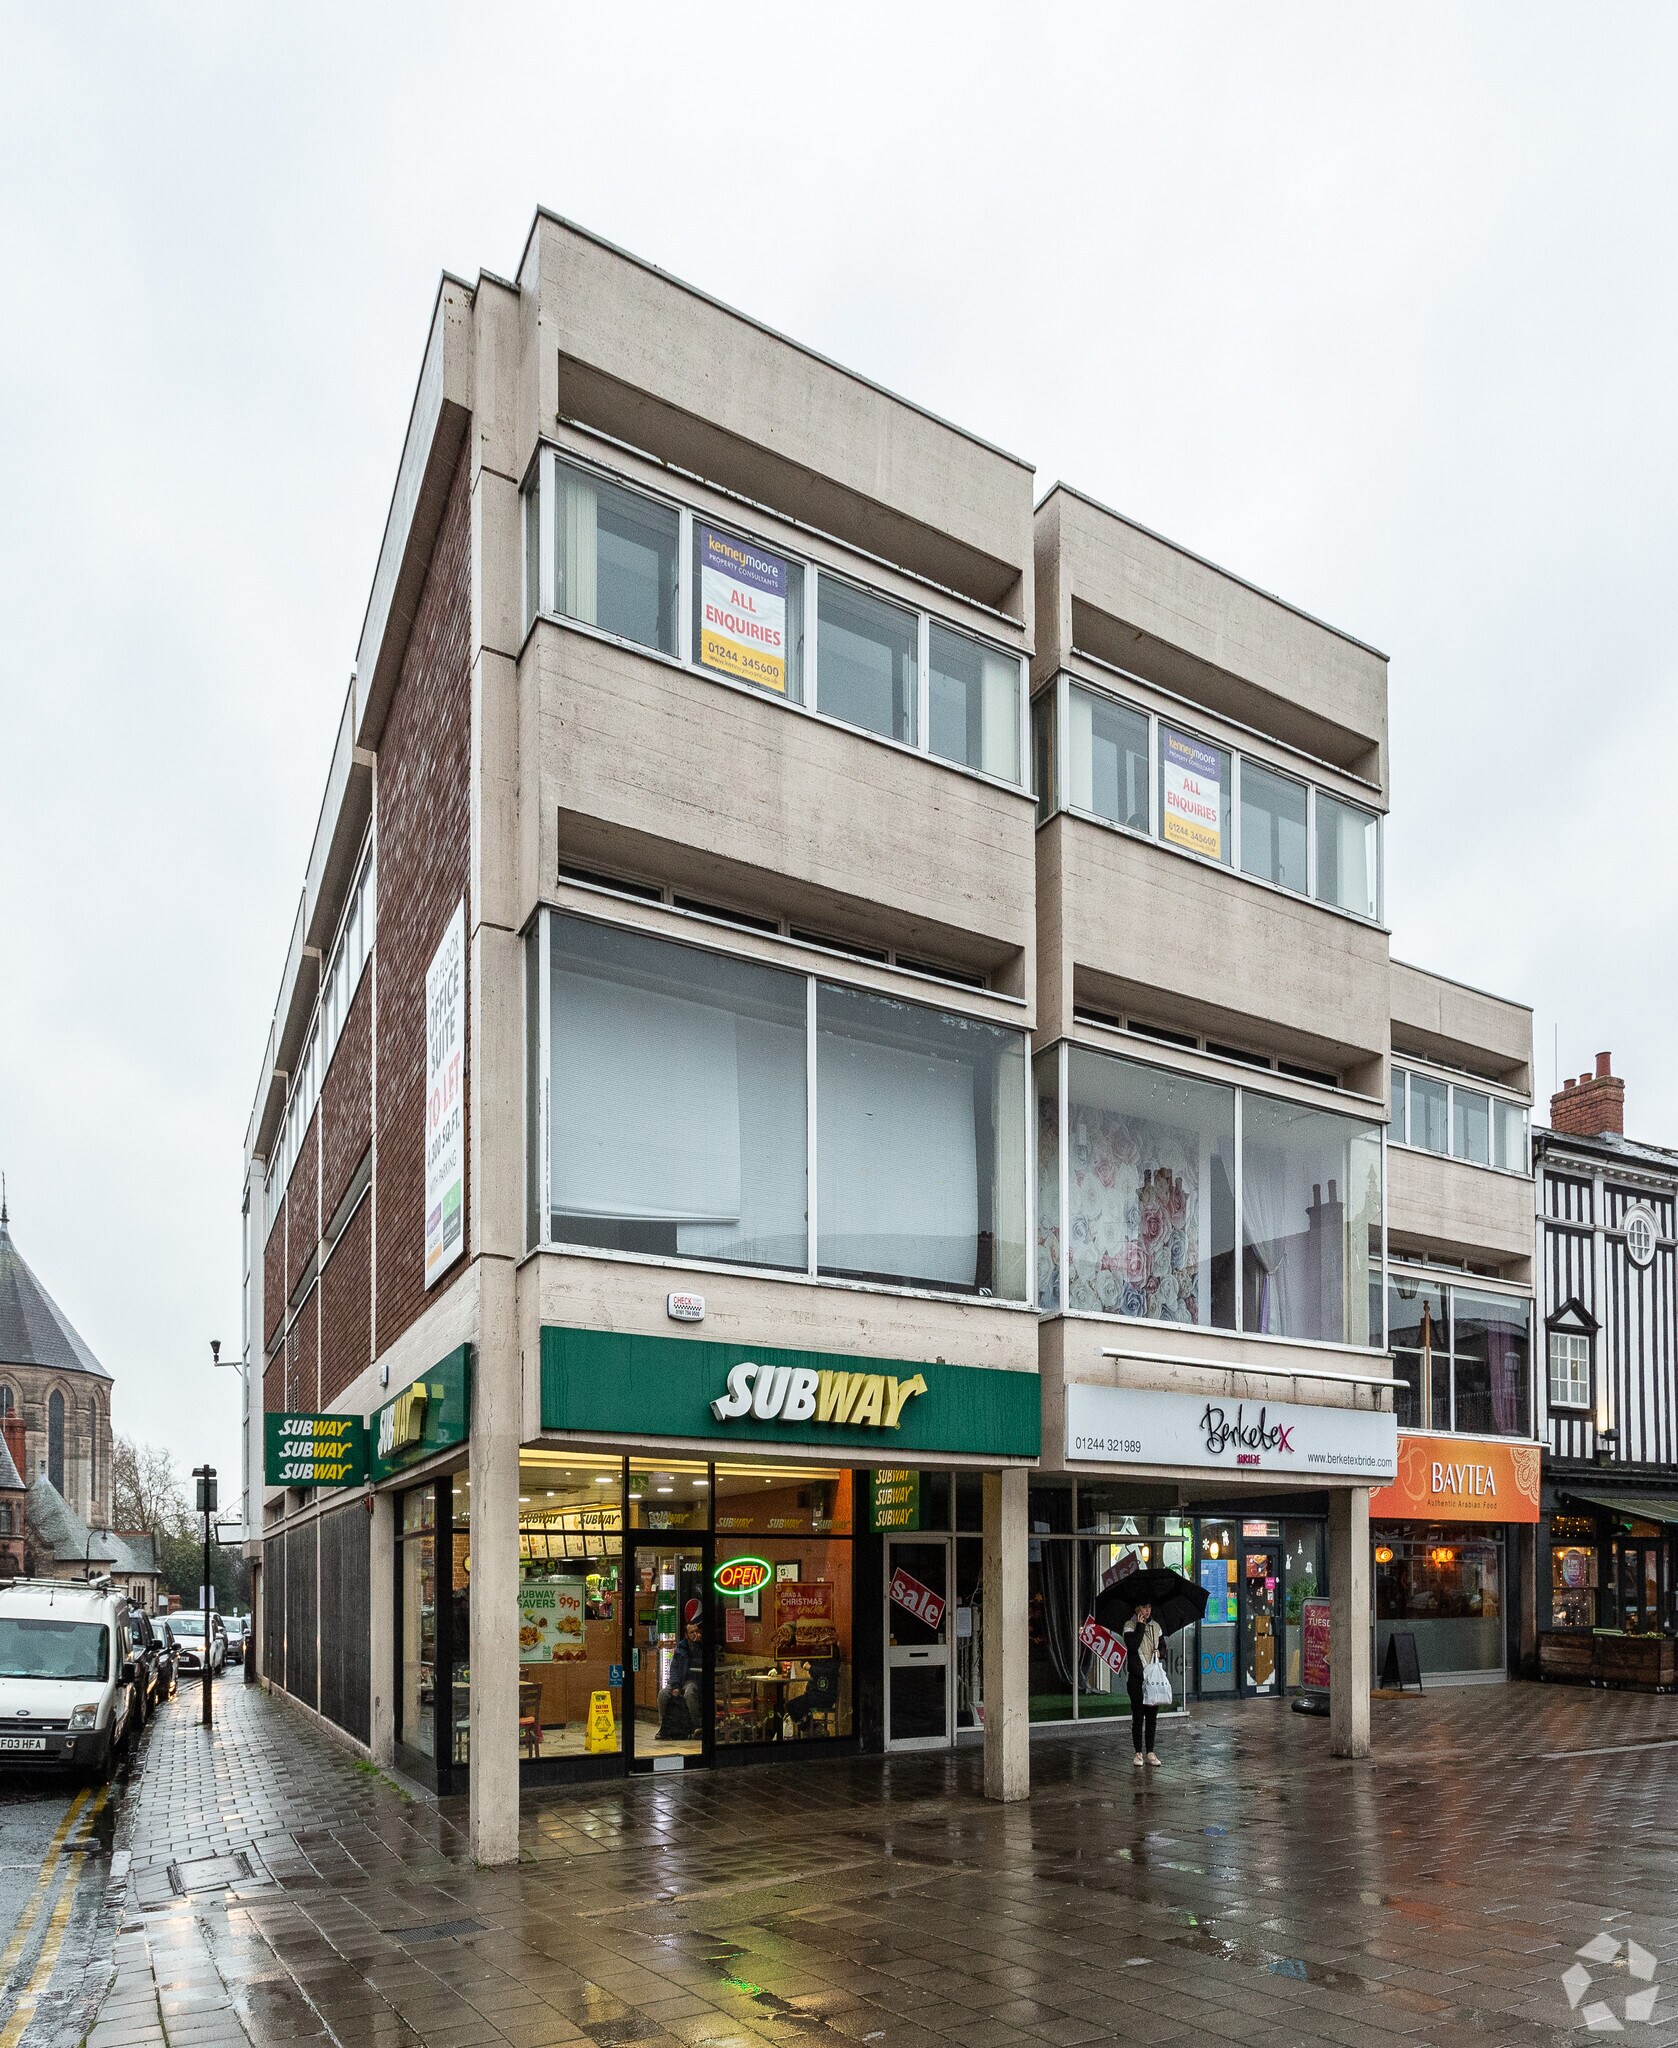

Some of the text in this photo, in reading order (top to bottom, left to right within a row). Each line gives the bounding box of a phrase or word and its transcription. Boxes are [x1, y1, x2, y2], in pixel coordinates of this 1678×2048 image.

[709, 534, 779, 577] kenneymoore
[709, 554, 778, 588] PROPERTY CONSULTANTS
[731, 590, 756, 613] ALL
[706, 604, 781, 646] ENQUIRIES
[708, 642, 779, 677] 01244 345600
[1169, 735, 1215, 766] kenneymoore
[1183, 778, 1200, 795] ALL
[1167, 791, 1216, 822] ENQUIRIES
[1168, 821, 1188, 837] 01244
[1190, 830, 1216, 847] 345600
[439, 923, 459, 988] FLOOR
[429, 953, 458, 1047] OFFICE
[431, 1002, 455, 1081] SUITE
[428, 1046, 460, 1138] TO LET
[673, 1296, 692, 1305] CHECK
[709, 1362, 928, 1427] SUBWAY
[278, 1419, 353, 1437] SUBWAY
[1200, 1403, 1295, 1453] Berketex
[278, 1441, 353, 1458] SUBWAY
[1075, 1437, 1142, 1453] 01244 321989
[1236, 1453, 1261, 1465] BRIDE
[1307, 1452, 1393, 1468] www.berketexbride.com
[278, 1463, 353, 1480] SUBWAY
[876, 1470, 909, 1484] SUBWAY
[1431, 1462, 1497, 1496] BAYTEA
[875, 1486, 913, 1505] SUBWAY
[1427, 1499, 1498, 1510] Authentic Arabian Food
[578, 1514, 620, 1525] SUBWAY
[717, 1518, 753, 1528] SUBWAY
[767, 1518, 803, 1529] SUBWAY
[875, 1509, 913, 1526] SUBWAY
[720, 1567, 763, 1585] OPEN
[518, 1590, 556, 1599] SUBWAY
[518, 1597, 581, 1610] SAVERS 99p
[781, 1598, 823, 1606] CHRISTMAS
[892, 1580, 939, 1623] sale
[1082, 1624, 1122, 1669] sale
[1201, 1651, 1233, 1675] bar
[22, 1740, 41, 1749] HFA
